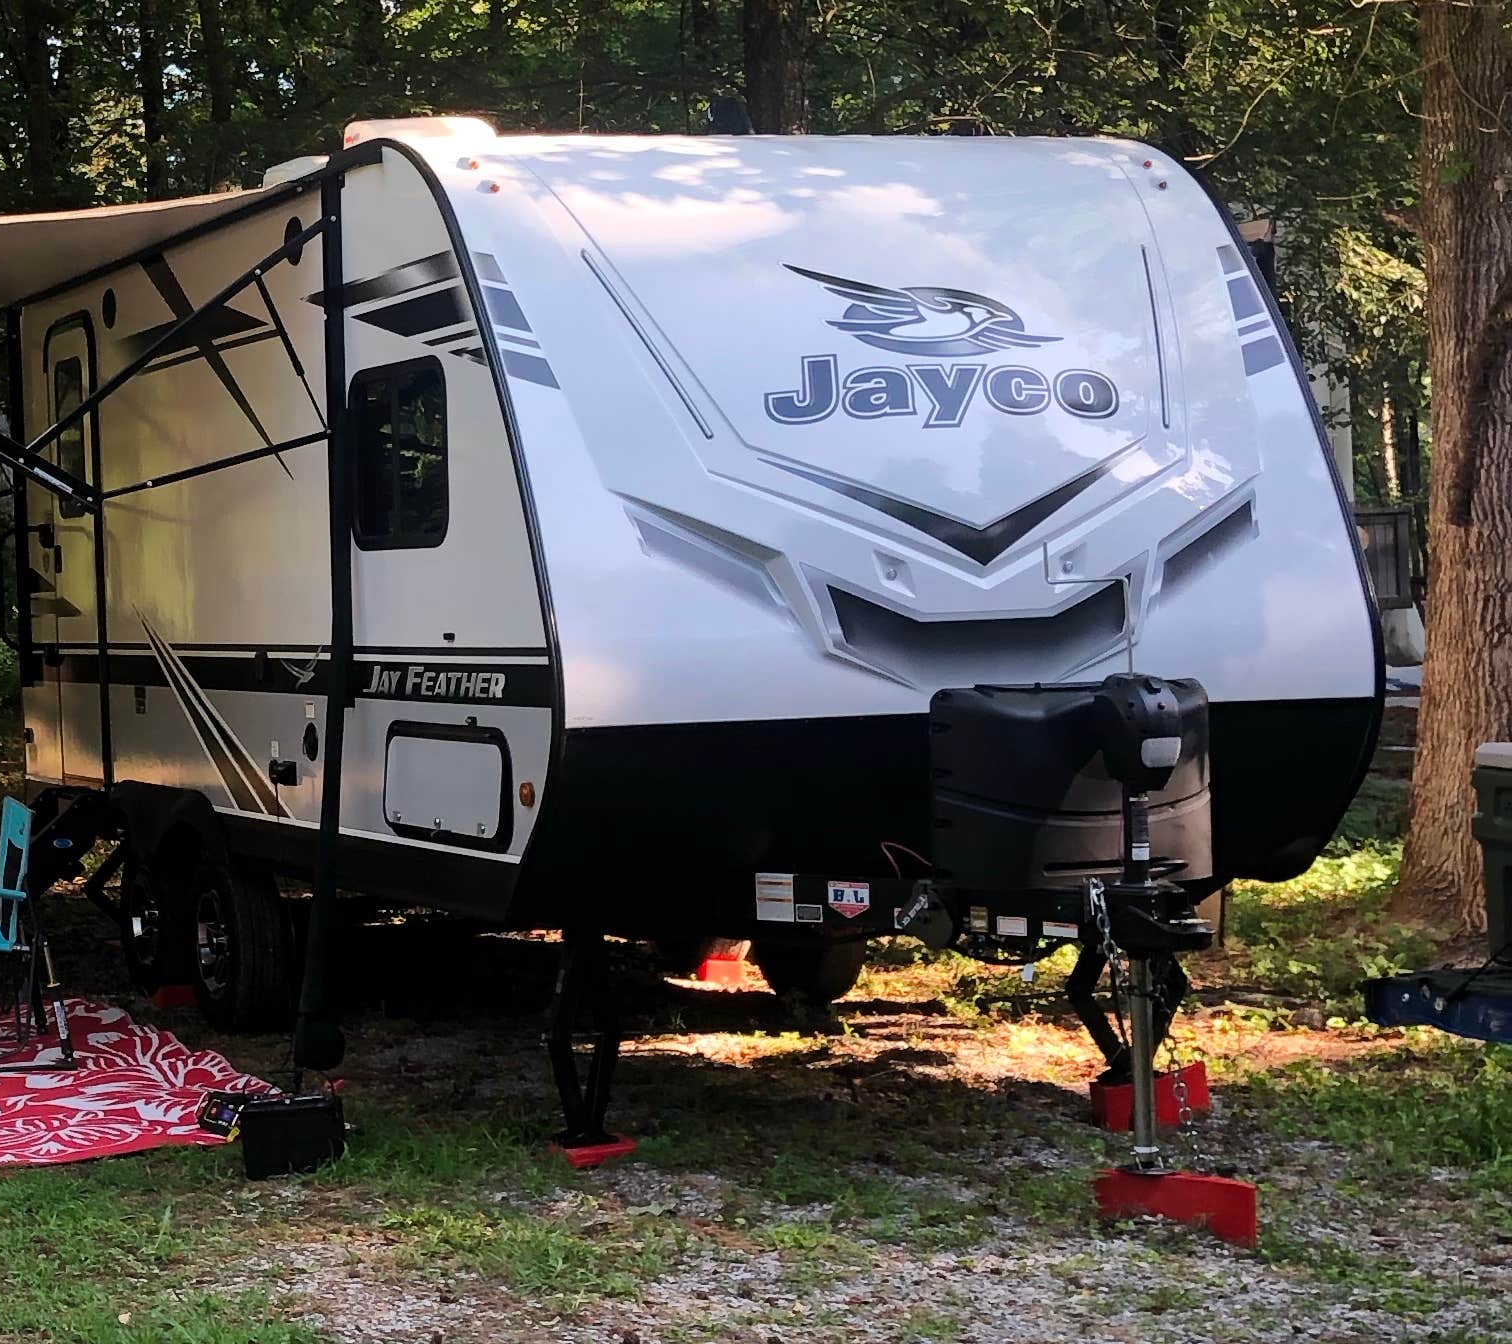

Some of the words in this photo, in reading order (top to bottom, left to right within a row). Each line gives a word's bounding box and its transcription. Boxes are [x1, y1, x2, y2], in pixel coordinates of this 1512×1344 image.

[763, 353, 1120, 429] Jayco
[363, 665, 402, 695] JAY
[405, 666, 506, 698] FEATHER
